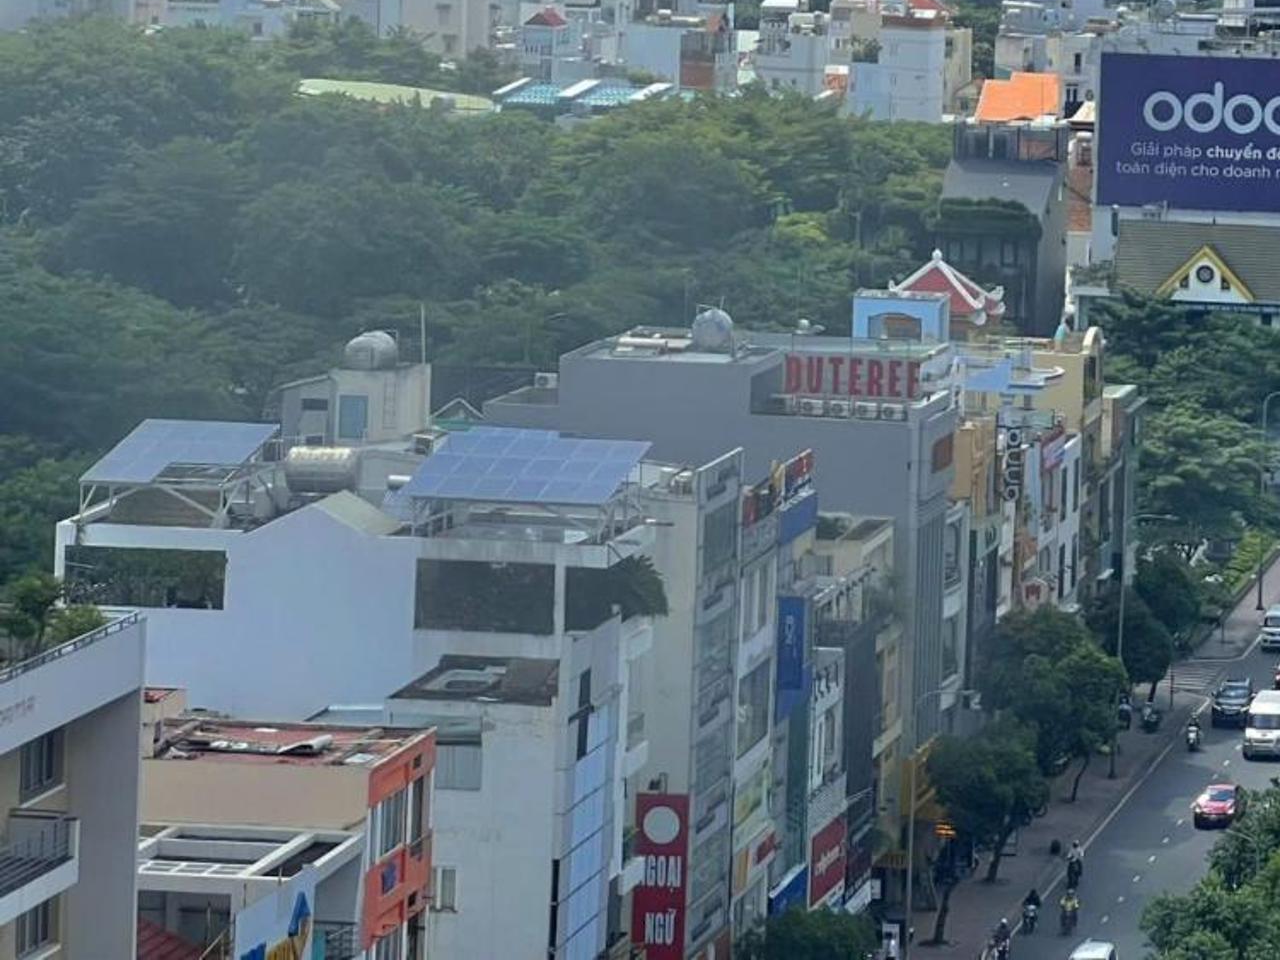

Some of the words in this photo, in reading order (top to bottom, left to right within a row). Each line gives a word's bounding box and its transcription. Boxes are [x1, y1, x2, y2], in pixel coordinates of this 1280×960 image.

[1131, 140, 1159, 157] Giải
[1163, 141, 1202, 161] pháp
[1206, 142, 1262, 164] chuyển
[1116, 158, 1150, 175] toàn
[1154, 160, 1187, 178] diện
[1191, 162, 1219, 178] cho
[1223, 162, 1271, 179] doanh
[641, 855, 682, 893] GOẠI
[644, 908, 677, 946] NGỮ
